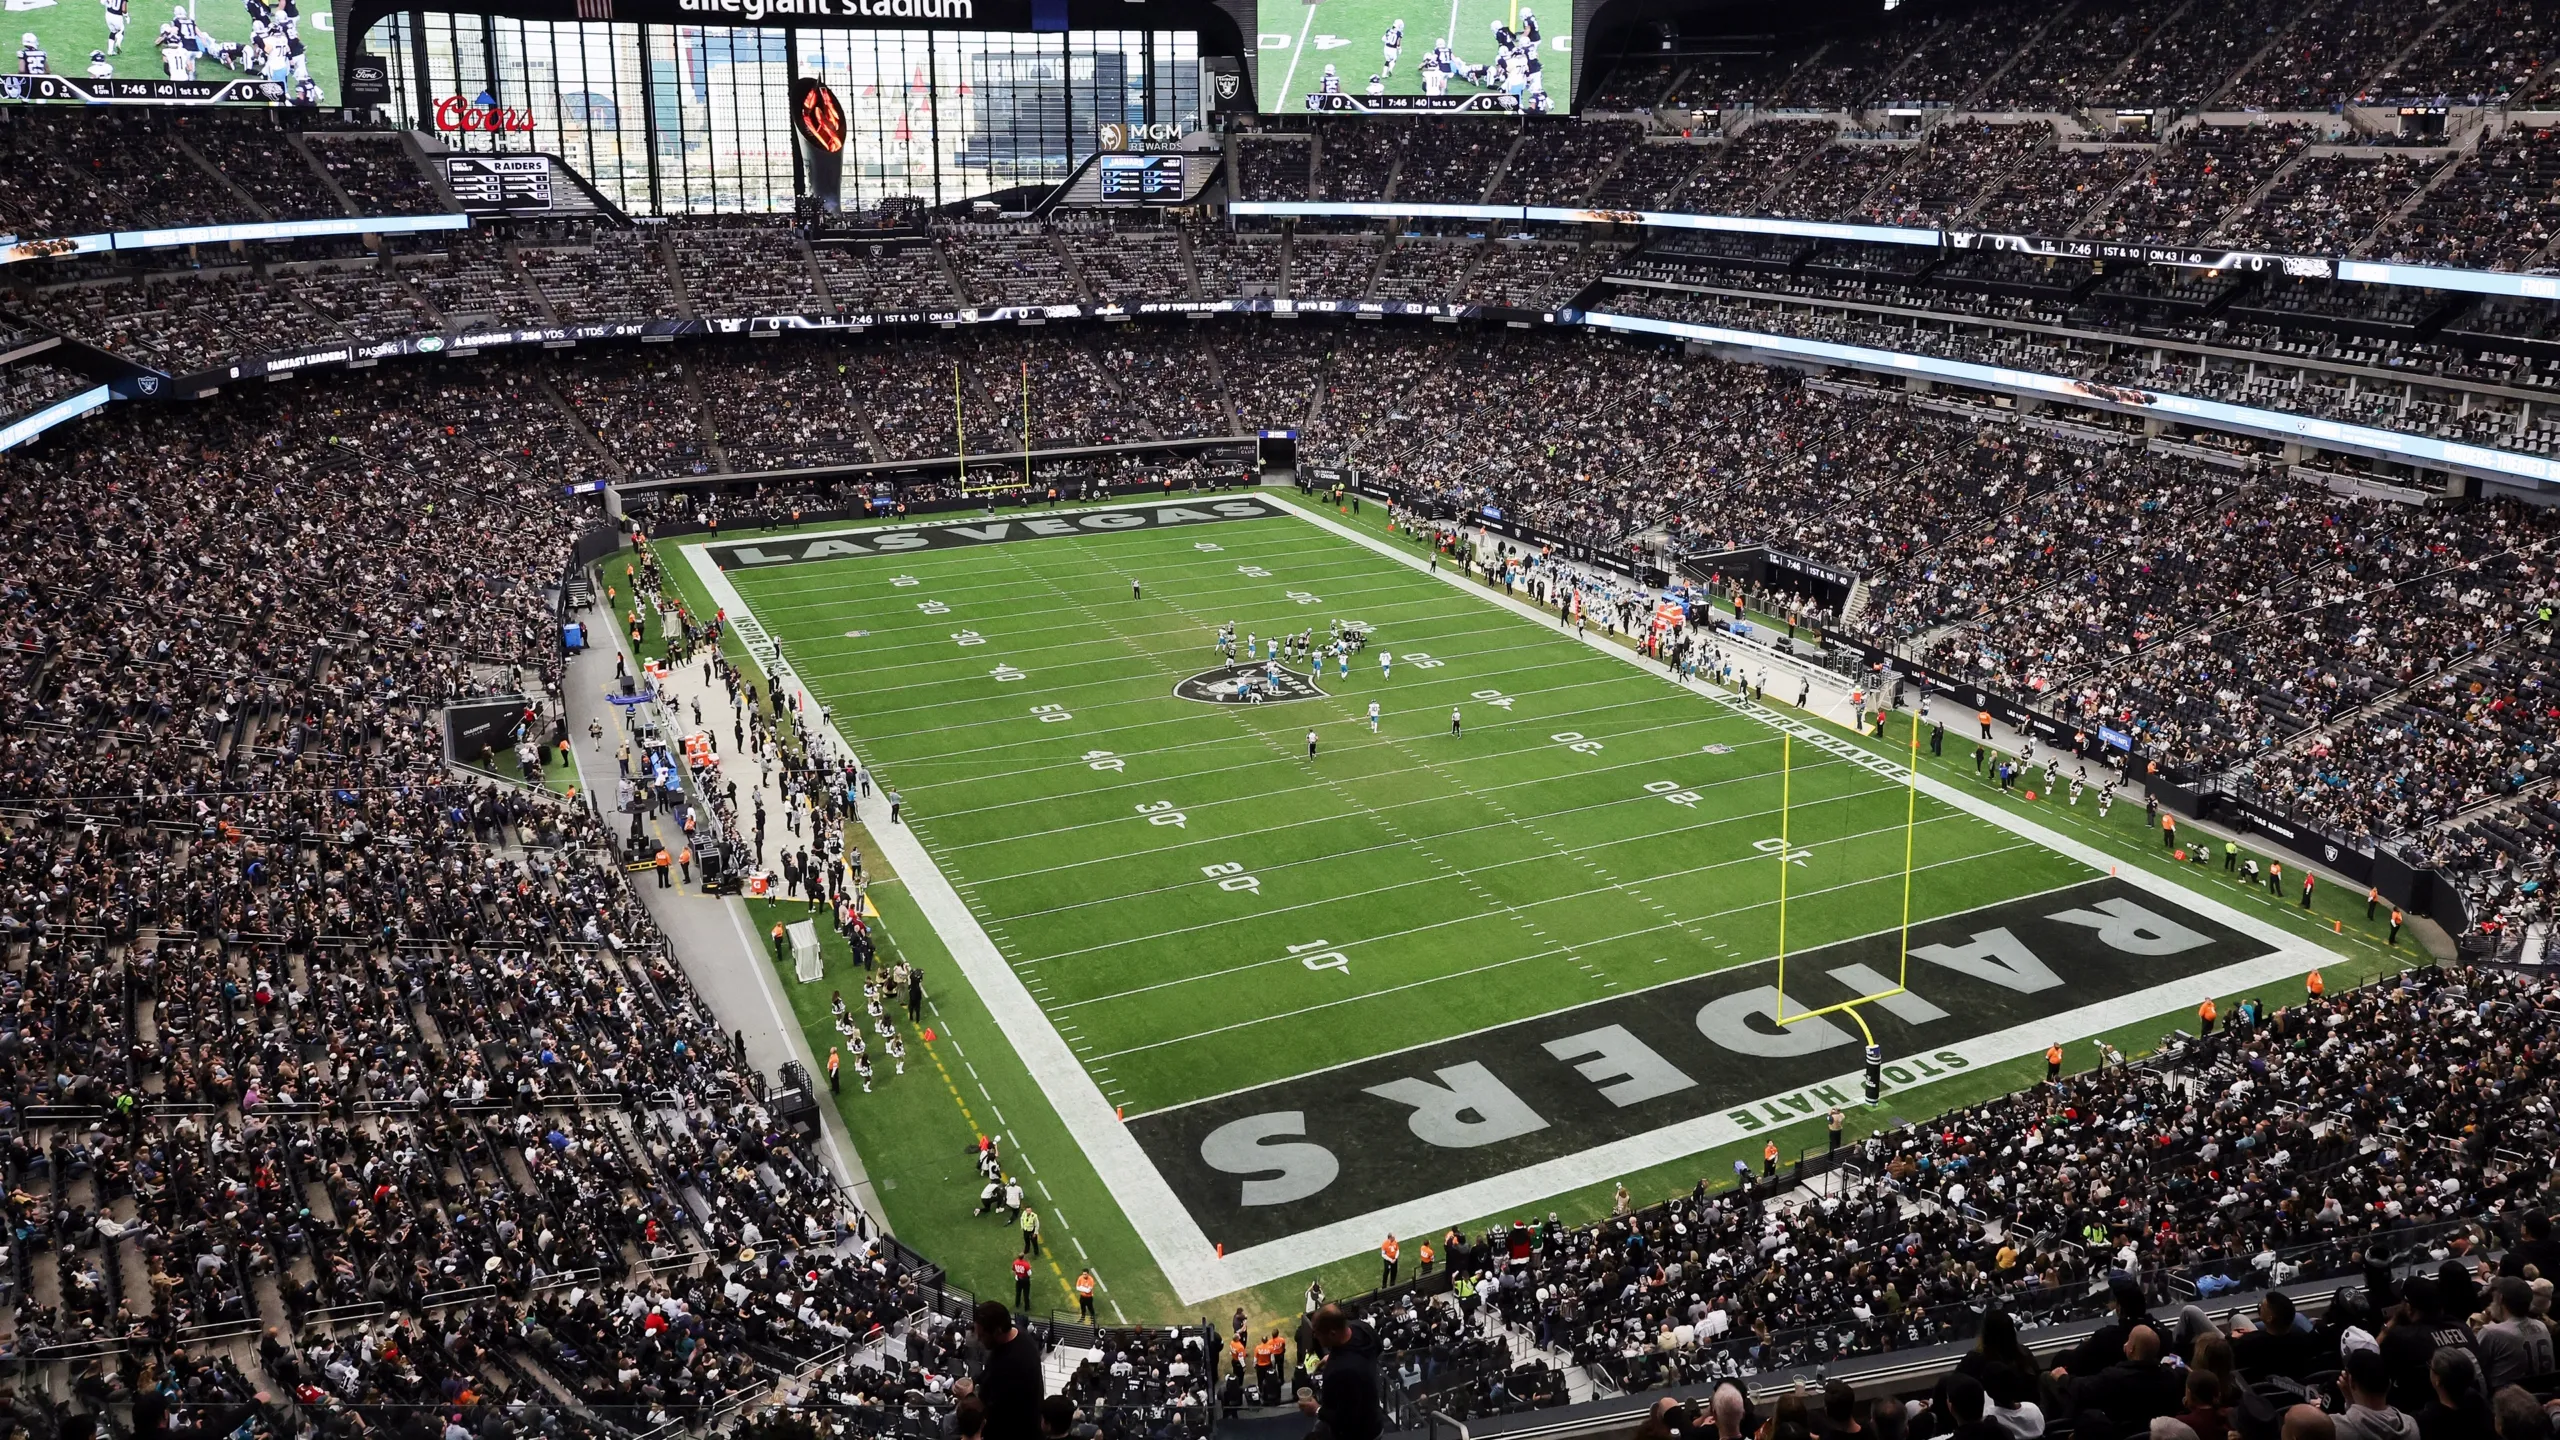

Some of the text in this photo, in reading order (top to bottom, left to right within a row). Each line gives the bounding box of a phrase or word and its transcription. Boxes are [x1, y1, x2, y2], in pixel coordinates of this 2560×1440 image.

[355, 68, 377, 79] Ford
[1055, 58, 1095, 80] GOUP
[40, 81, 54, 96] 0
[121, 85, 147, 95] 7:46
[158, 85, 172, 95] 40
[180, 88, 192, 96] 1st
[201, 88, 210, 96] 10
[242, 86, 253, 99] 0
[1332, 97, 1341, 109] 0
[433, 95, 537, 131] Coors
[1130, 124, 1182, 139] MGM
[451, 132, 527, 151] LIGHT
[494, 162, 542, 170] RAIDERS
[1109, 158, 1144, 167] JAGUARS
[1995, 238, 2004, 250] 0
[2069, 243, 2091, 255] 7:46
[2103, 247, 2118, 257] 1ST
[2128, 248, 2139, 258] 10
[2150, 250, 2177, 261] ON 43
[2188, 253, 2201, 263] 40
[2252, 257, 2262, 271] 0
[1159, 303, 1170, 312] OF
[1425, 305, 1440, 314] ATL
[851, 316, 873, 325] 7:46
[910, 314, 919, 322] 10
[944, 312, 953, 320] 43
[544, 329, 565, 339] YDS
[584, 327, 604, 337] TDS
[626, 325, 643, 334] INT
[769, 319, 779, 330] 0
[358, 343, 398, 358] PASSING
[267, 350, 347, 372] FANTASY LEADERS
[944, 501, 1267, 541] VEGAS
[733, 532, 930, 565] LAS
[1787, 559, 1801, 571] 7:46
[950, 628, 986, 647] 30
[732, 615, 792, 677] INSPIRE CHAN
[1401, 652, 1445, 670] 50
[989, 661, 1025, 682] 40
[1470, 689, 1515, 711] 40
[1030, 703, 1072, 723] 50
[1551, 731, 1603, 755] 30
[1718, 692, 1912, 780] INSPIRE CHANGE
[1080, 750, 1125, 772] 40
[1643, 780, 1703, 807] 20
[1135, 800, 1187, 827] 30
[2268, 822, 2294, 839] RAIDERS
[1200, 862, 1260, 893] 20
[1286, 938, 1349, 971] 10
[1200, 897, 2216, 1207] RAIDERS
[1727, 1084, 1848, 1132] HATE
[2522, 1338, 2552, 1374] 16
